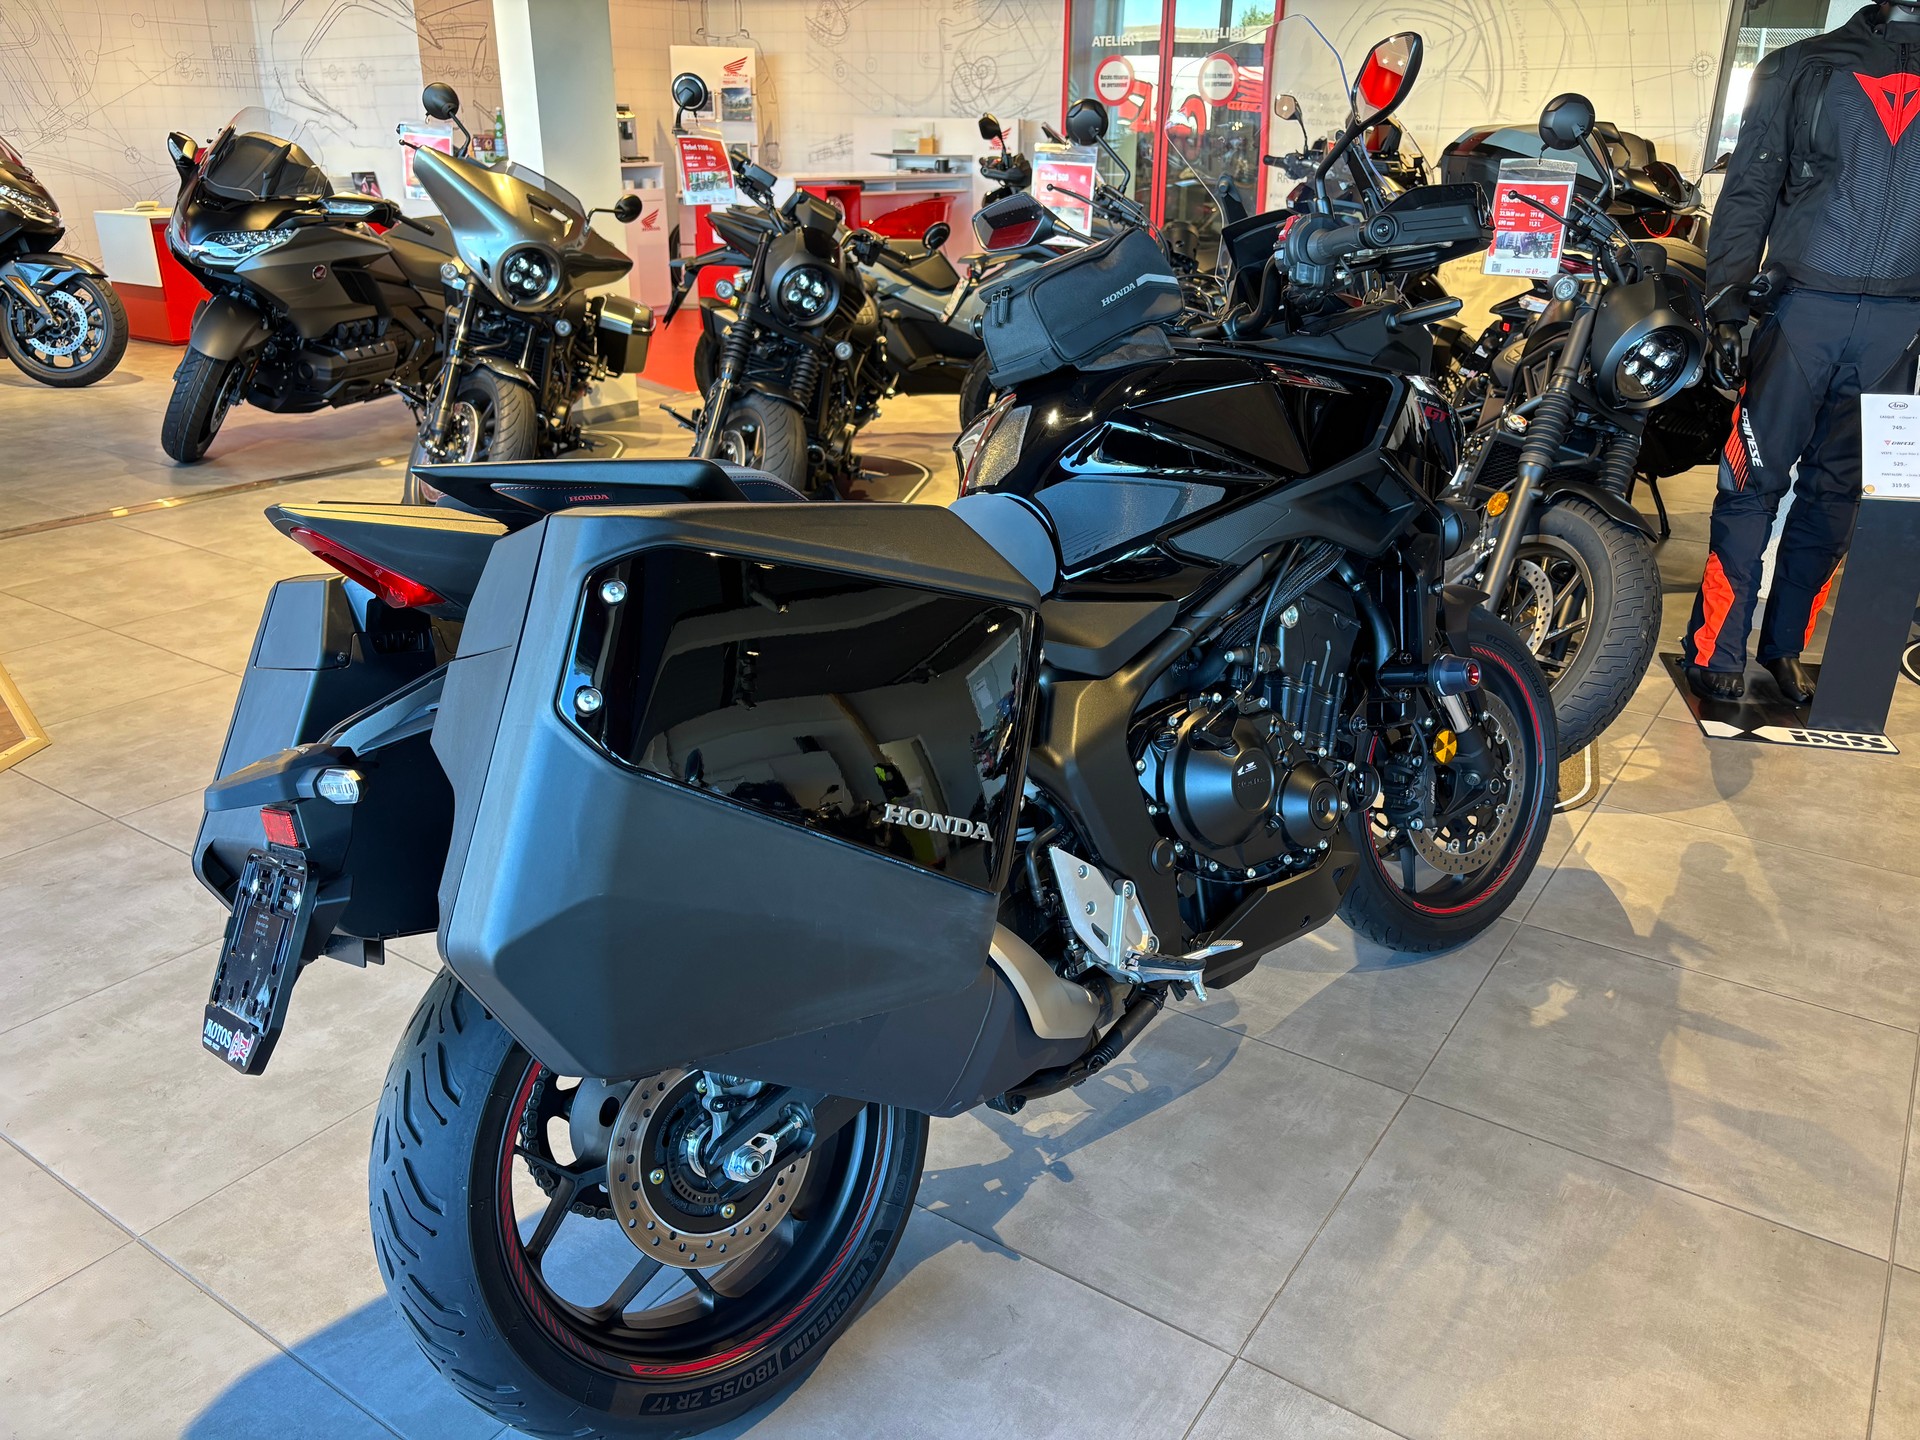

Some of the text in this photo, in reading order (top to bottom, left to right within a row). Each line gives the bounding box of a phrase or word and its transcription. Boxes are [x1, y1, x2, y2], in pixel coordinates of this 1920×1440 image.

[1092, 35, 1135, 47] ATELIER
[1201, 26, 1246, 41] ATELIER
[1101, 282, 1136, 307] HONDA
[1424, 406, 1449, 422] GT
[1741, 407, 1763, 467] DAINESE
[569, 494, 609, 502] HONDA
[882, 803, 993, 842] HONDA
[203, 1018, 233, 1049] MOTOS
[789, 1262, 869, 1360] MICHELIN
[648, 1360, 776, 1412] 180/55 ZR 17
